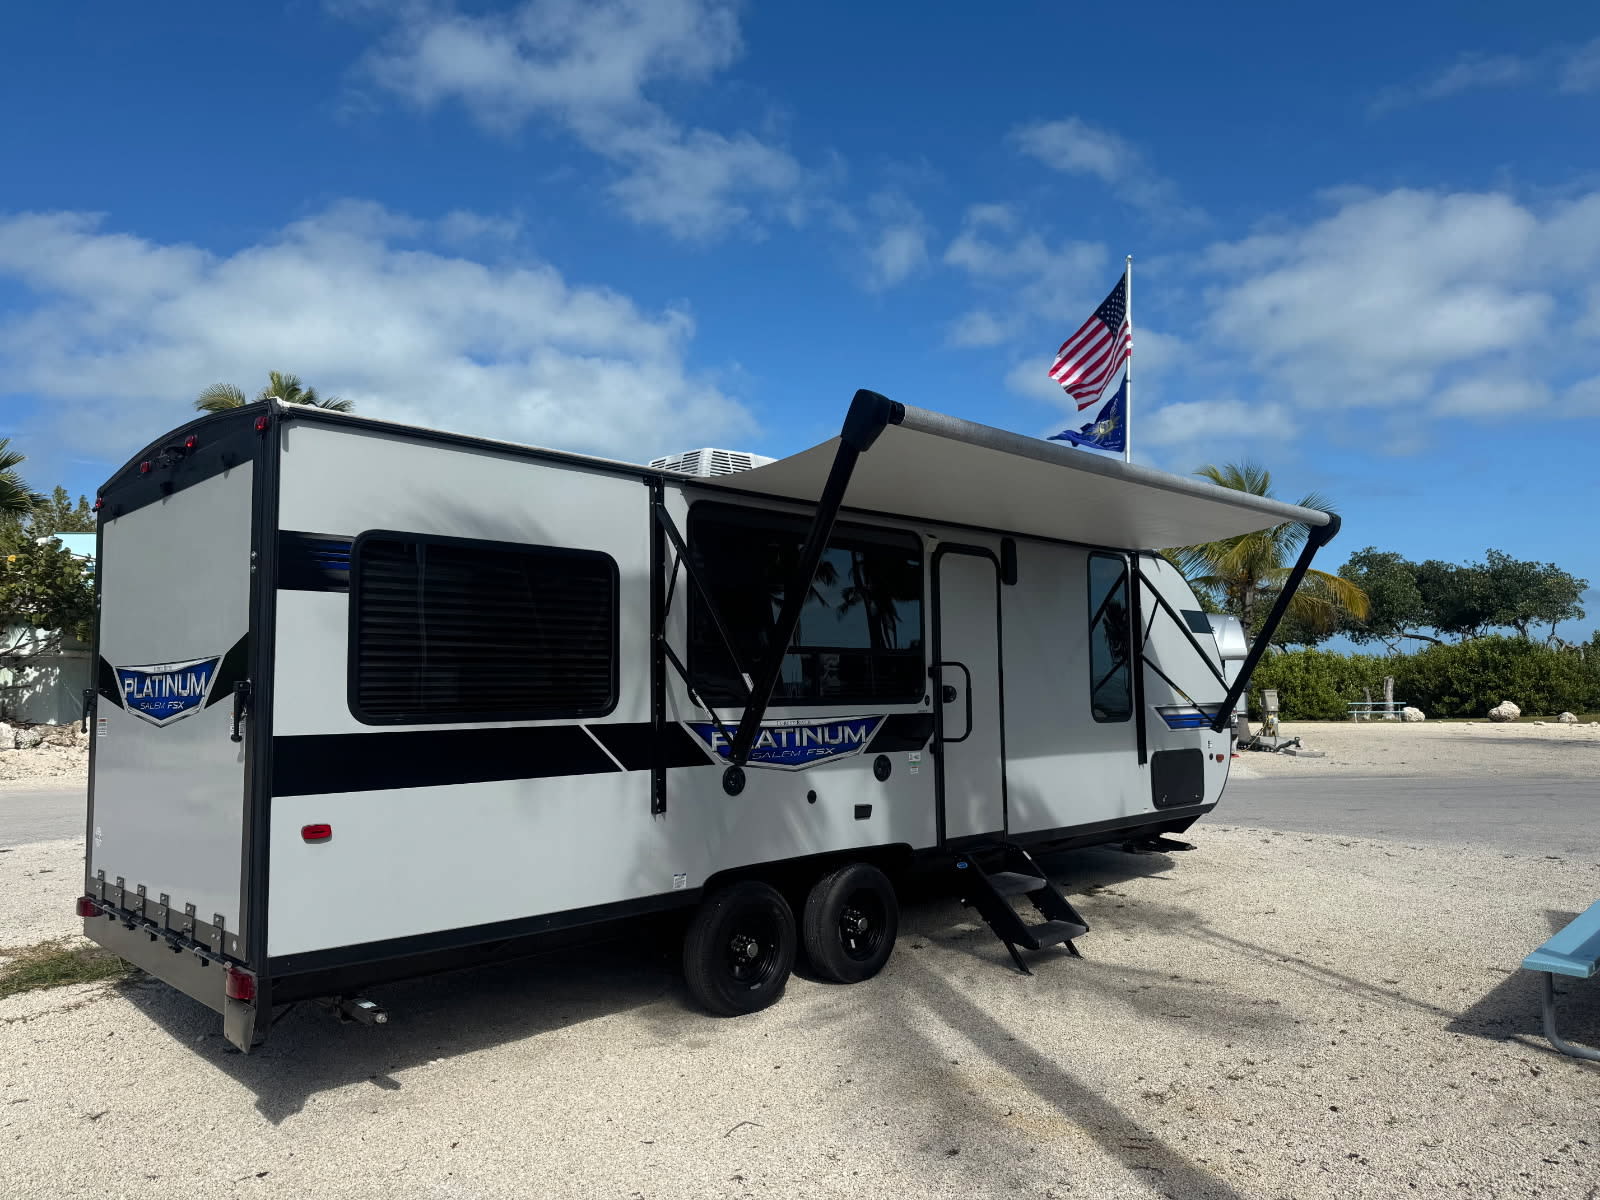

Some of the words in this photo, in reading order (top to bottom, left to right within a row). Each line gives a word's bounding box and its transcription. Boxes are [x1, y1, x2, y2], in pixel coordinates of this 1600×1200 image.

[124, 672, 206, 699] PLATINUM
[140, 702, 165, 710] SALEM
[167, 701, 185, 710] FSX
[711, 725, 866, 752] PATINUM
[752, 750, 801, 760] SALEM
[807, 748, 836, 756] FSX
